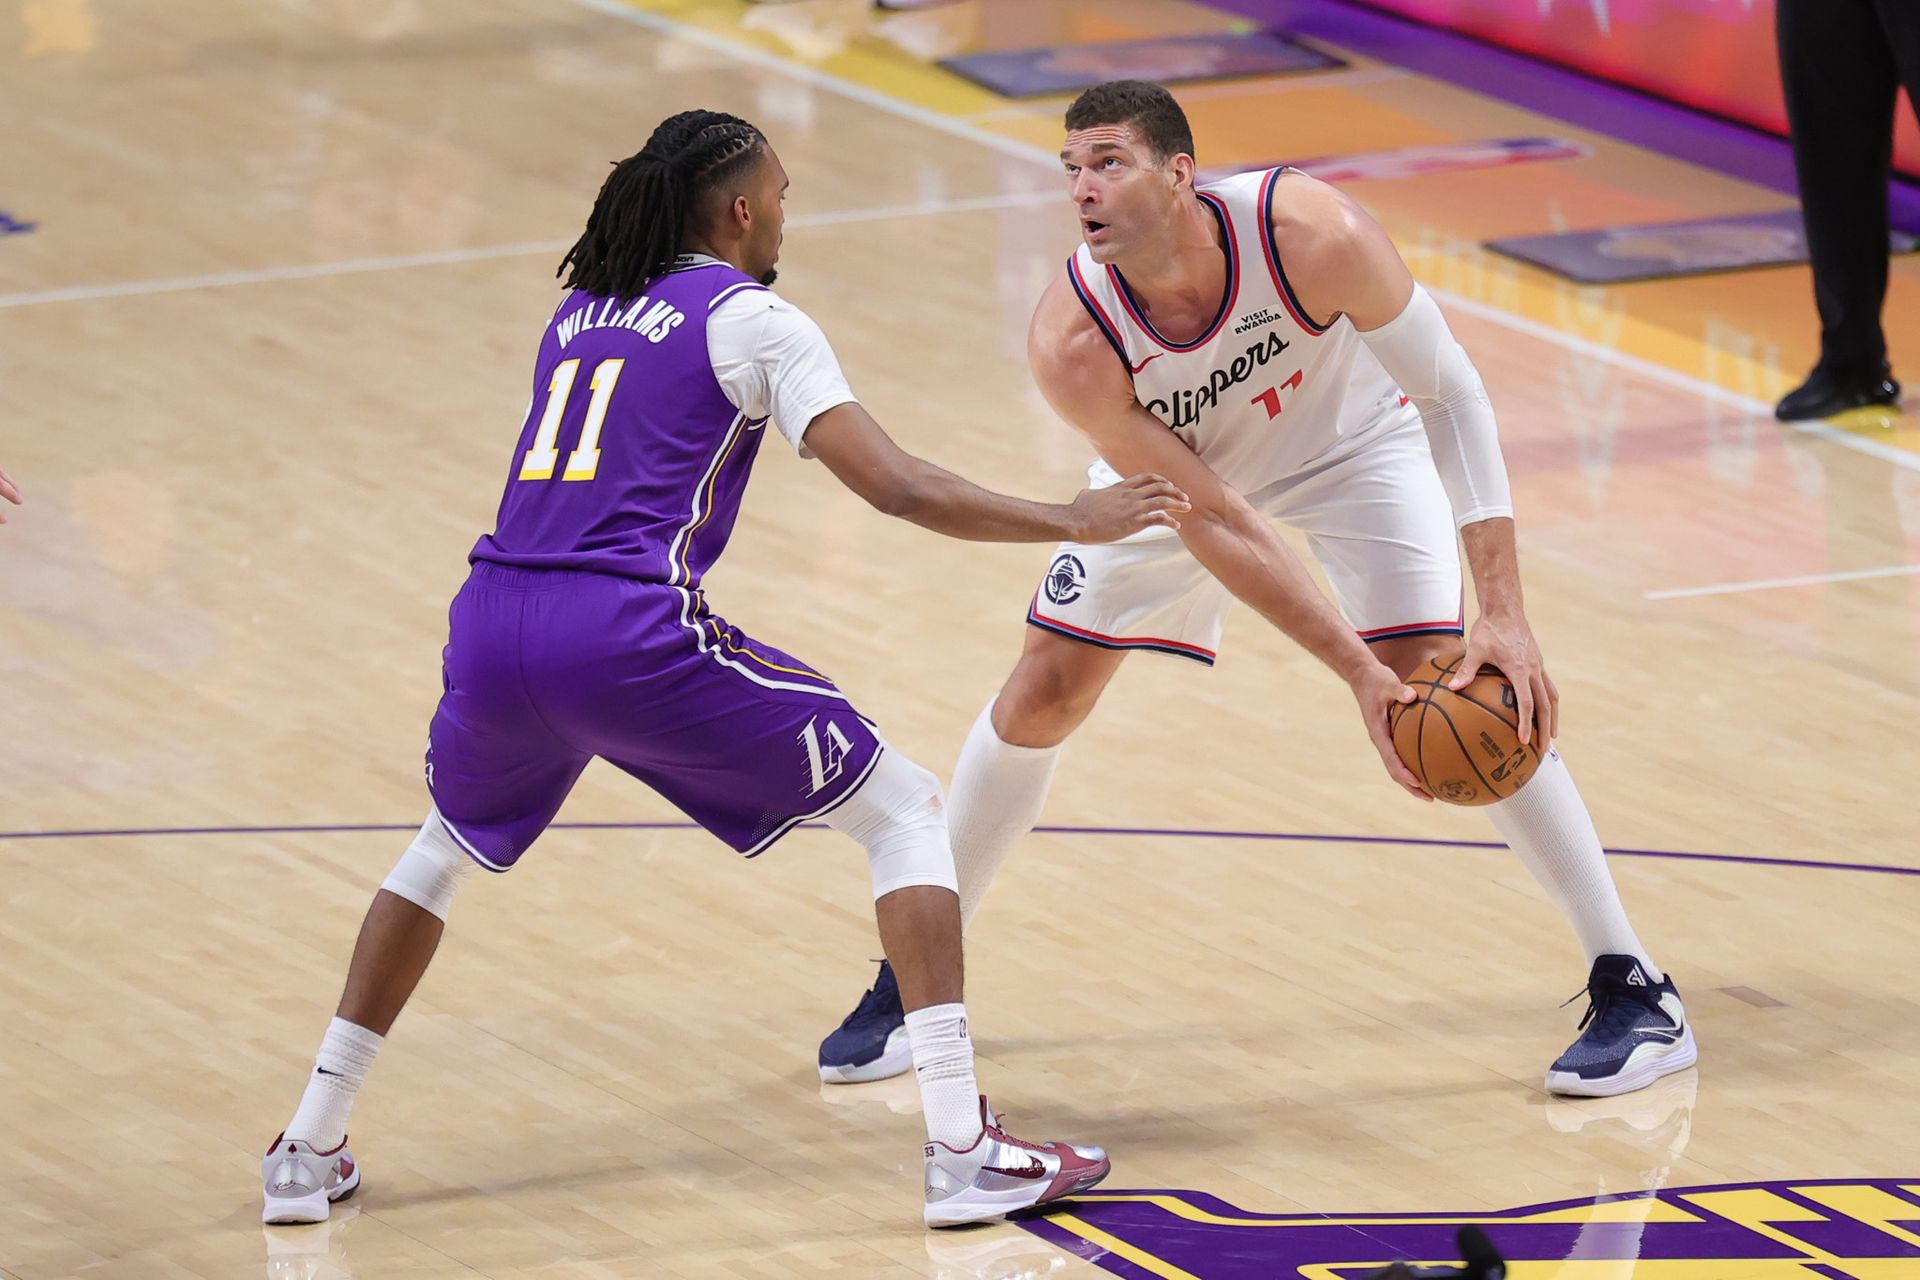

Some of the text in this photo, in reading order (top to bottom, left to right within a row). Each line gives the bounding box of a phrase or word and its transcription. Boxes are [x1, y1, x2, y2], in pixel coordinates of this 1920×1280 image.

[556, 296, 686, 350] WILLIAMS
[1234, 313, 1282, 334] RWANDA
[1241, 309, 1268, 323] VISIT
[518, 358, 626, 482] 11
[796, 714, 855, 799] LA
